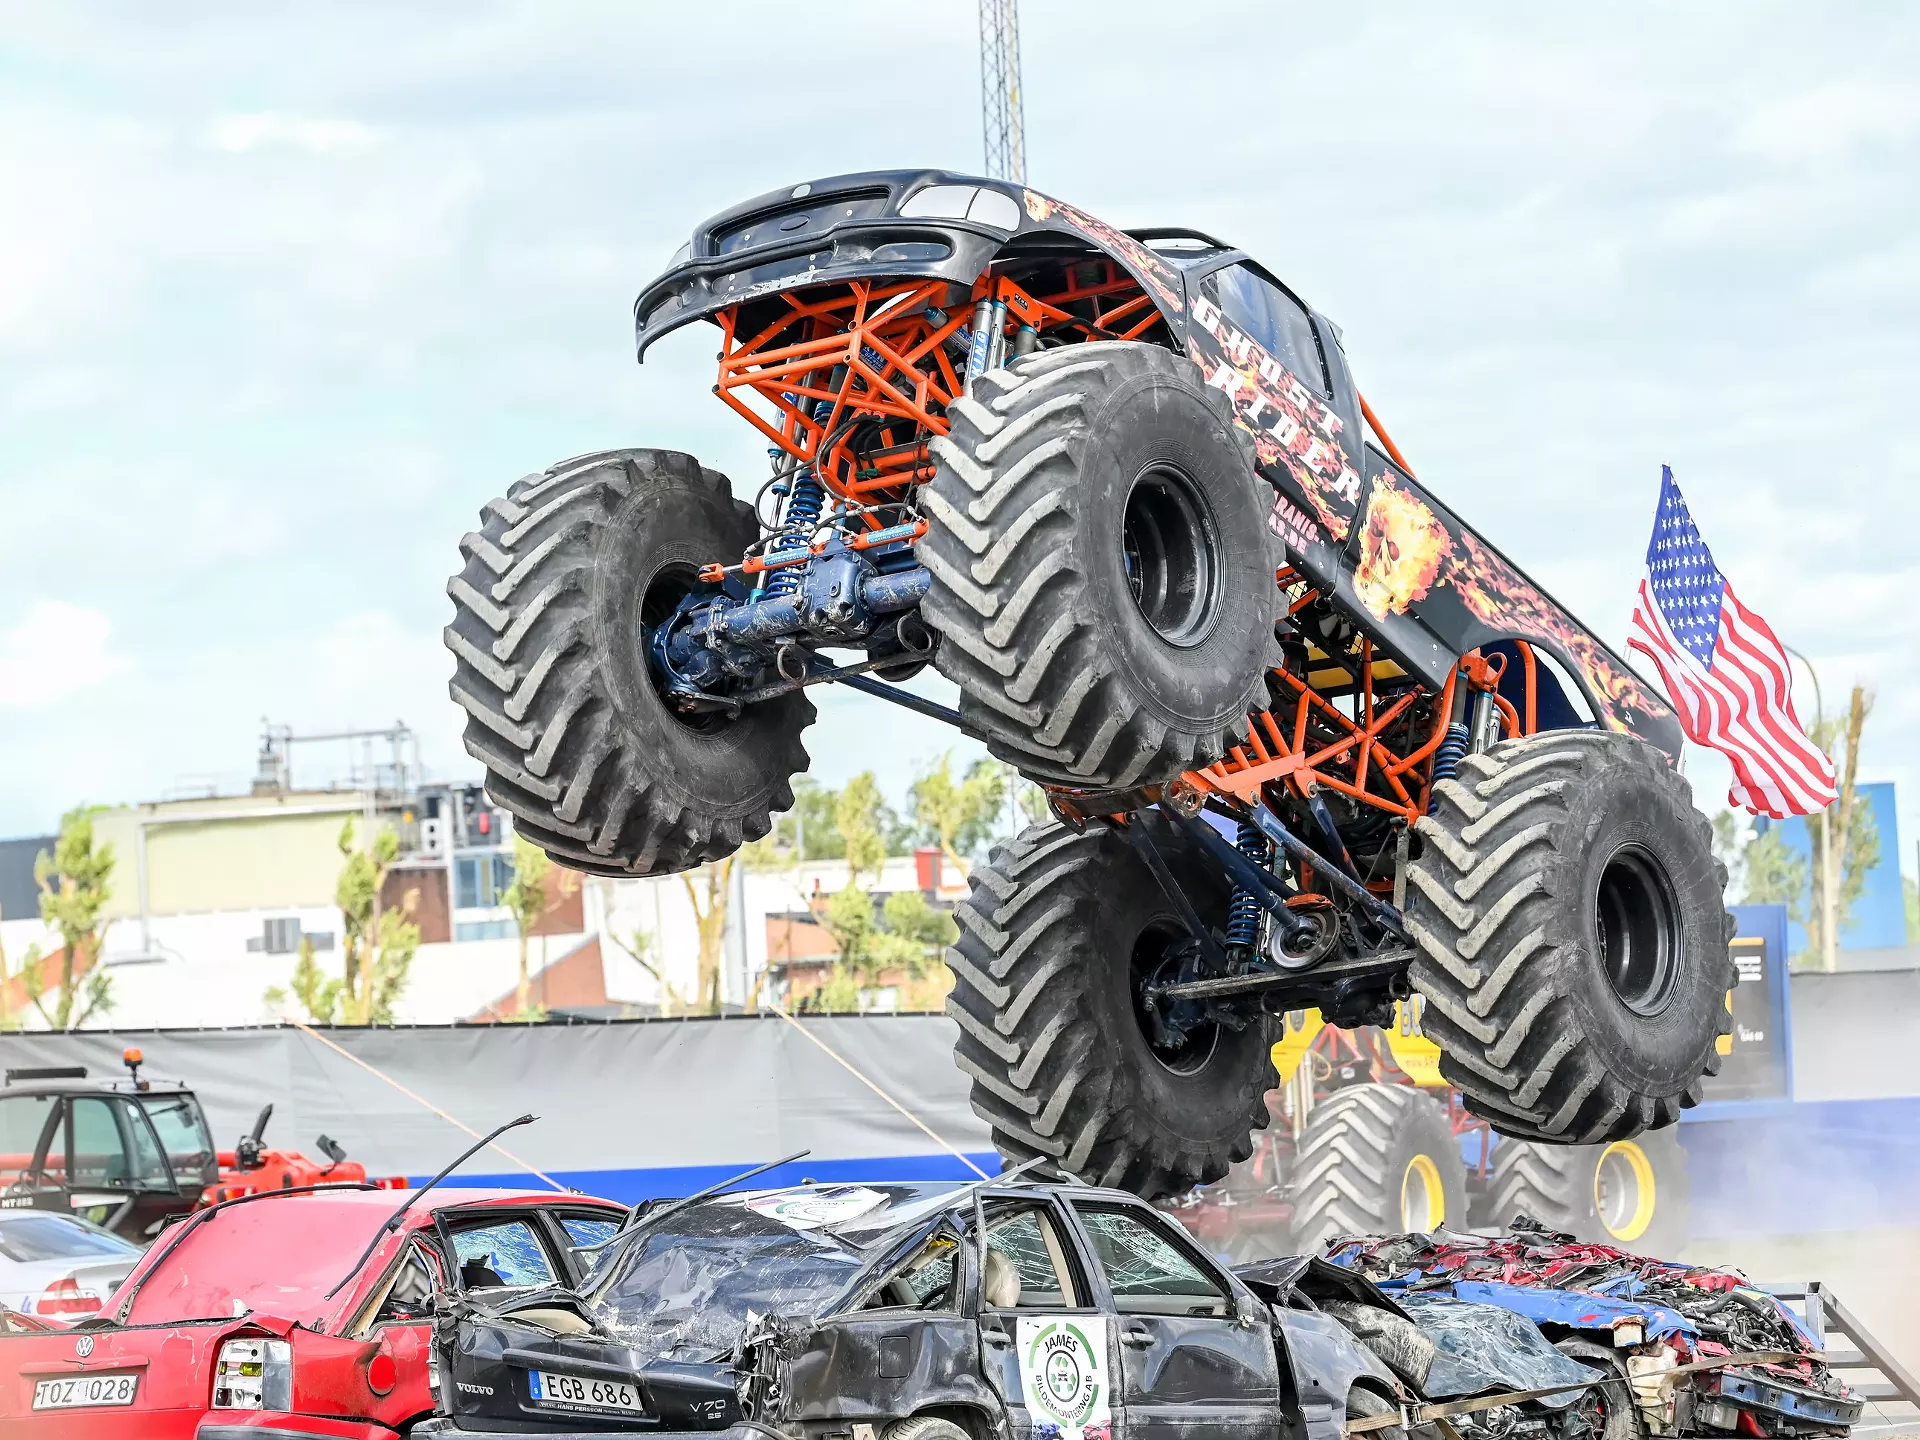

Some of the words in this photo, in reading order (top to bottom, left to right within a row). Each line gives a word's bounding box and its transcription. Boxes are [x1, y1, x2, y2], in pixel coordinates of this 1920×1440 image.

[970, 330, 987, 377] KING
[1192, 295, 1344, 439] GHOST
[1205, 355, 1361, 507] RIDER
[1044, 1334, 1078, 1353] JAMES
[40, 1381, 76, 1405] TOZ
[456, 1381, 494, 1396] VOLVO
[546, 1375, 585, 1400] EGB
[592, 1382, 631, 1406] 686
[1035, 1375, 1090, 1419] BILDEMONTERING
[1085, 1375, 1093, 1392] AB
